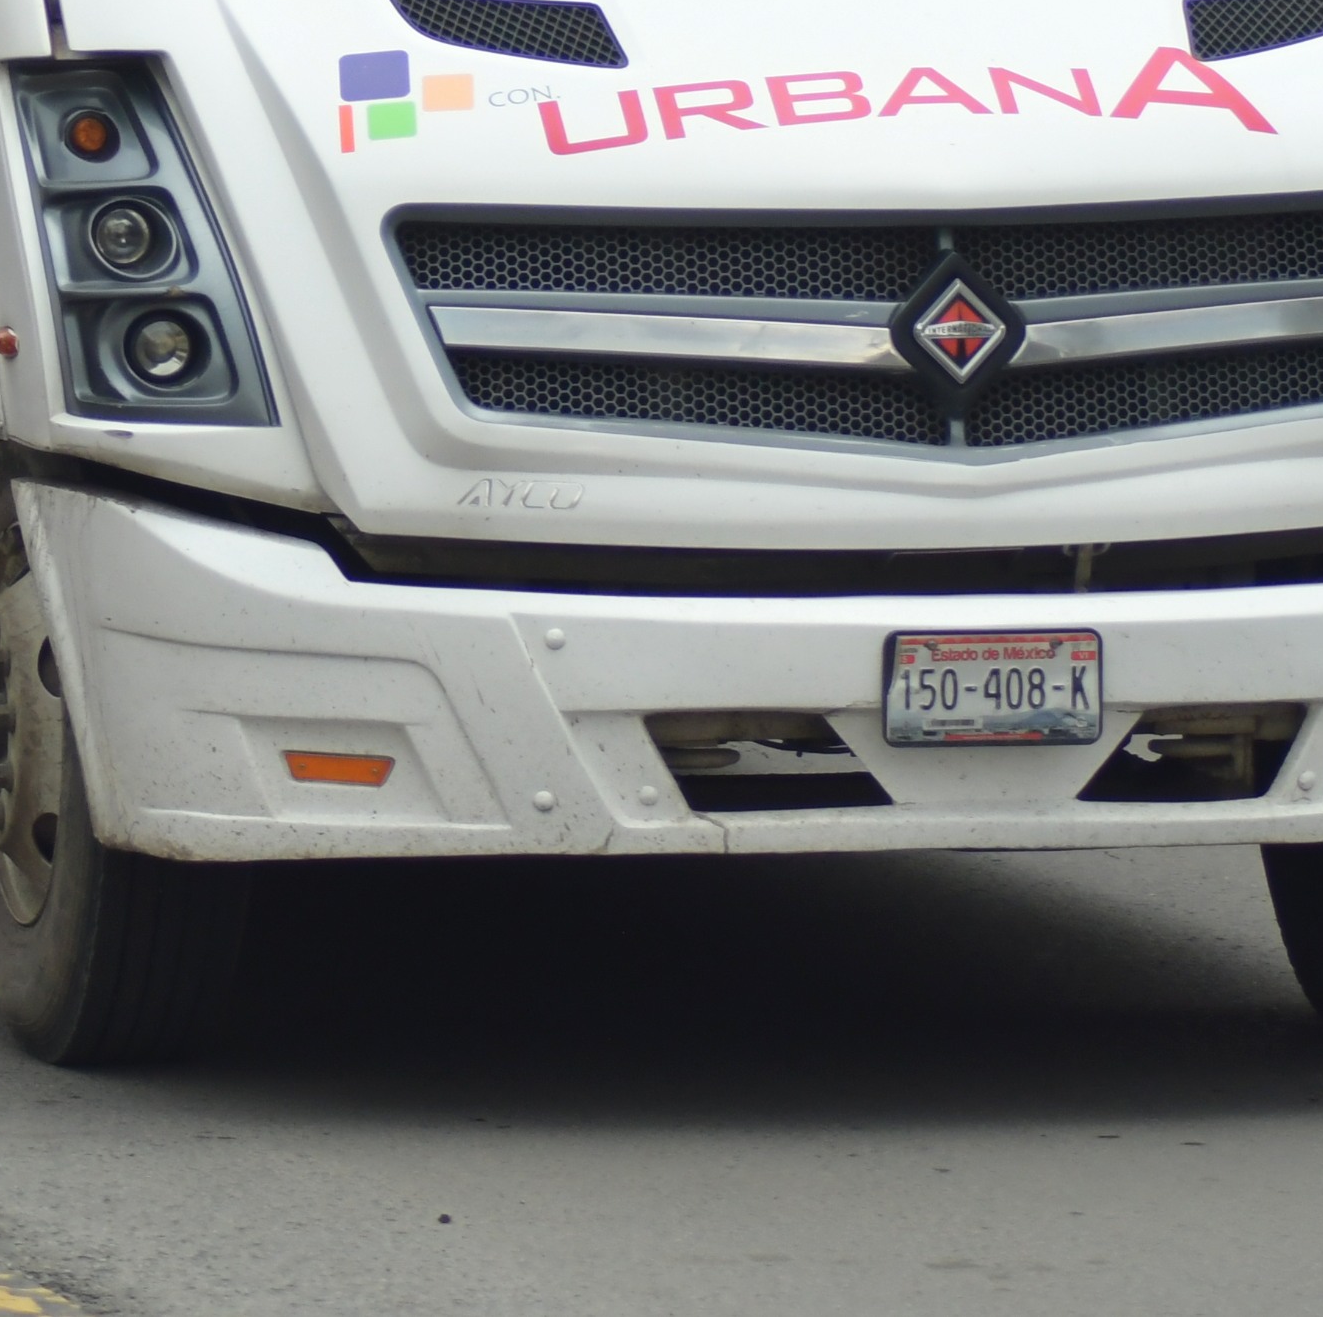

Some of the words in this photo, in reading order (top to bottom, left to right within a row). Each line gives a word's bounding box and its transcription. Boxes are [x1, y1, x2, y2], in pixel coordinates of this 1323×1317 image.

[538, 46, 1279, 156] URBANA
[931, 647, 978, 662] Estado
[982, 647, 1000, 661] de
[1003, 645, 1057, 660] México
[900, 665, 1091, 712] 150-408-K
